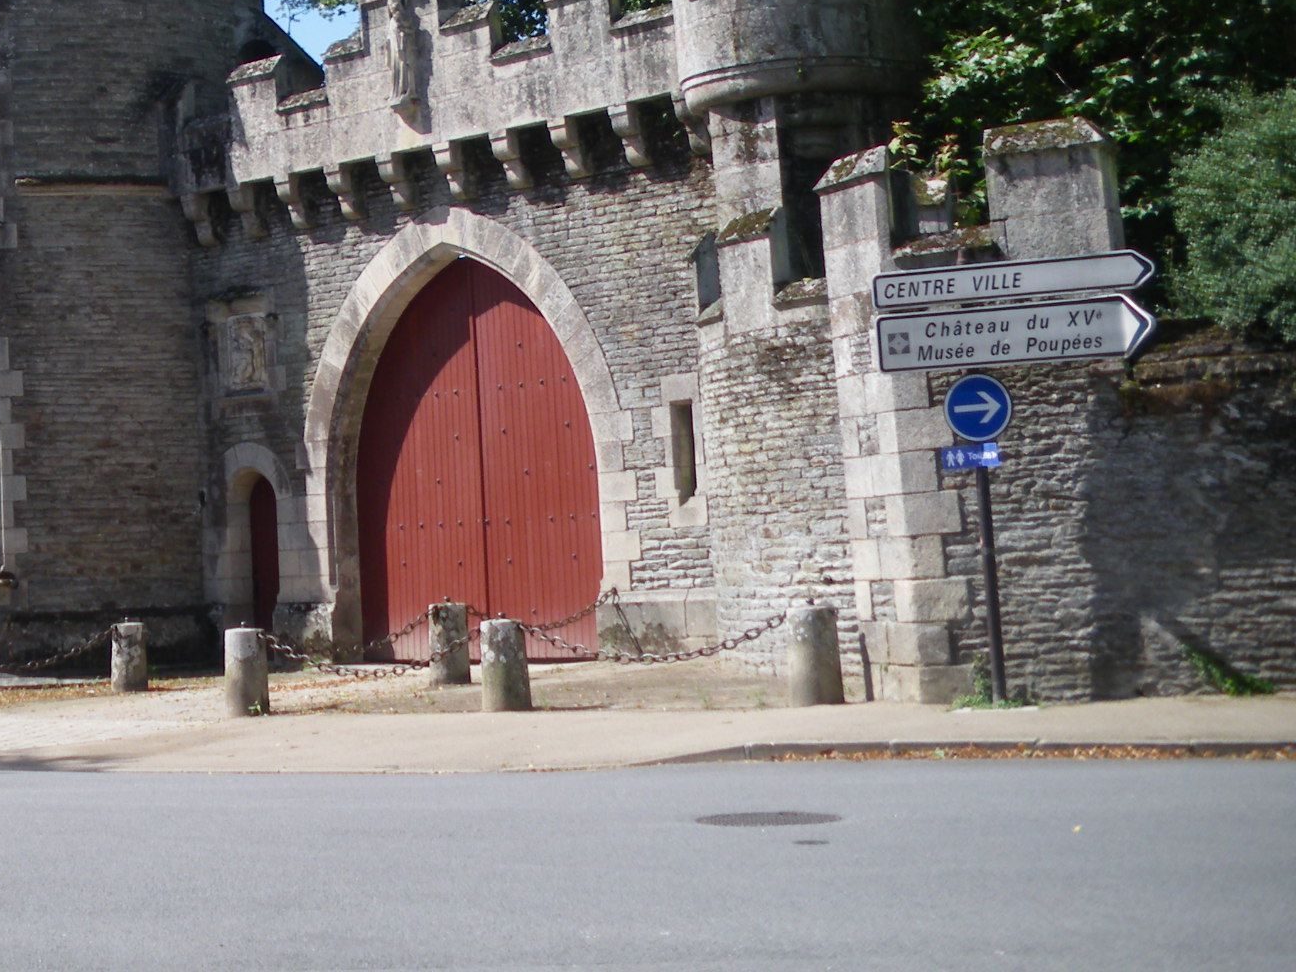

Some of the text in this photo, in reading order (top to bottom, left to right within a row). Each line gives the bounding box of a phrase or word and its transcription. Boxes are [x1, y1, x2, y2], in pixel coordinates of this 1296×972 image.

[884, 272, 1022, 299] CENTRE VILLE
[925, 318, 1010, 339] Château
[1027, 313, 1049, 330] du
[917, 333, 1103, 362] Musée de Poupées
